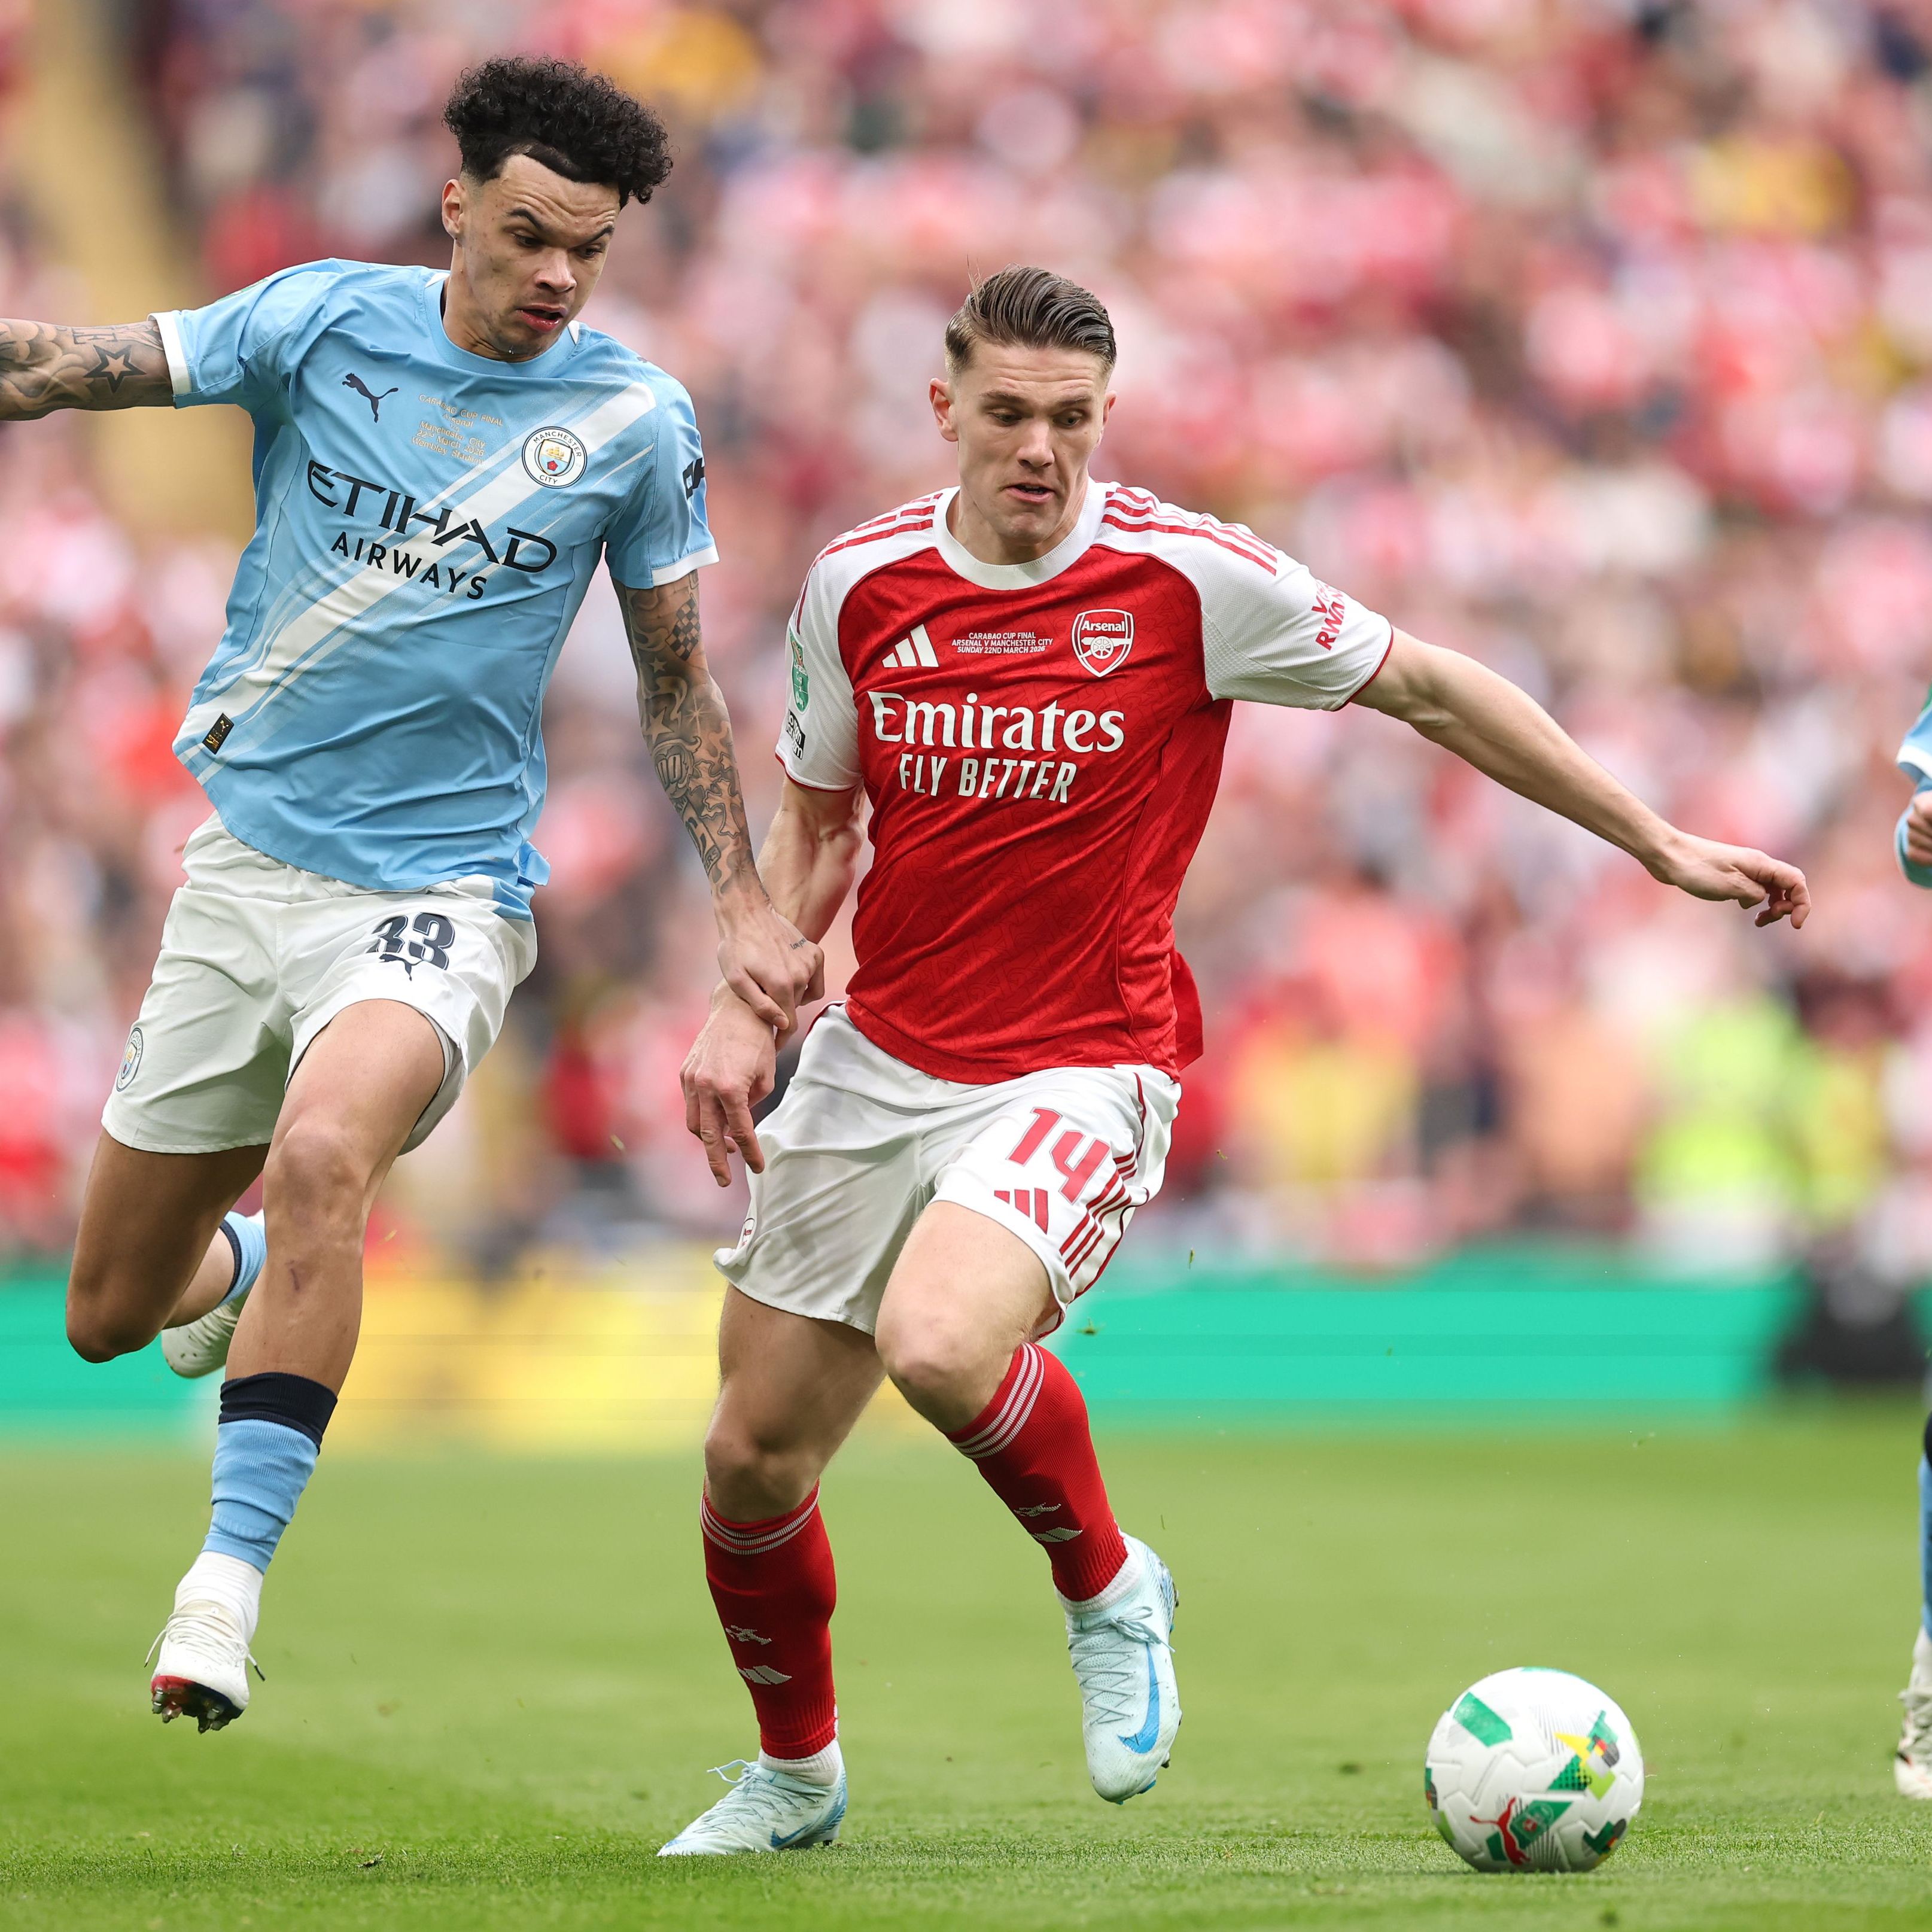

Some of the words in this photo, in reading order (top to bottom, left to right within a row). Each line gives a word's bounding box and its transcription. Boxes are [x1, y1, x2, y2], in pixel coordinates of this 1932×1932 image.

[443, 413, 474, 427] Arsenal
[460, 409, 478, 418] CUP
[481, 415, 503, 426] FINAL
[412, 437, 448, 455] Wembley
[420, 421, 464, 440] Manchester
[469, 437, 485, 448] City
[436, 436, 461, 448] March
[464, 446, 485, 457] 2026
[533, 431, 582, 457] MANCHESTER
[540, 474, 558, 484] CITY
[308, 460, 557, 573] ETIHAD
[330, 531, 487, 600] AIRWAYS
[1081, 620, 1125, 632] Arsenal
[867, 690, 1125, 753] Emirates
[899, 753, 948, 796] FLY
[958, 757, 1077, 804] BETTER
[365, 911, 455, 970] 33
[1005, 1107, 1110, 1206] 14
